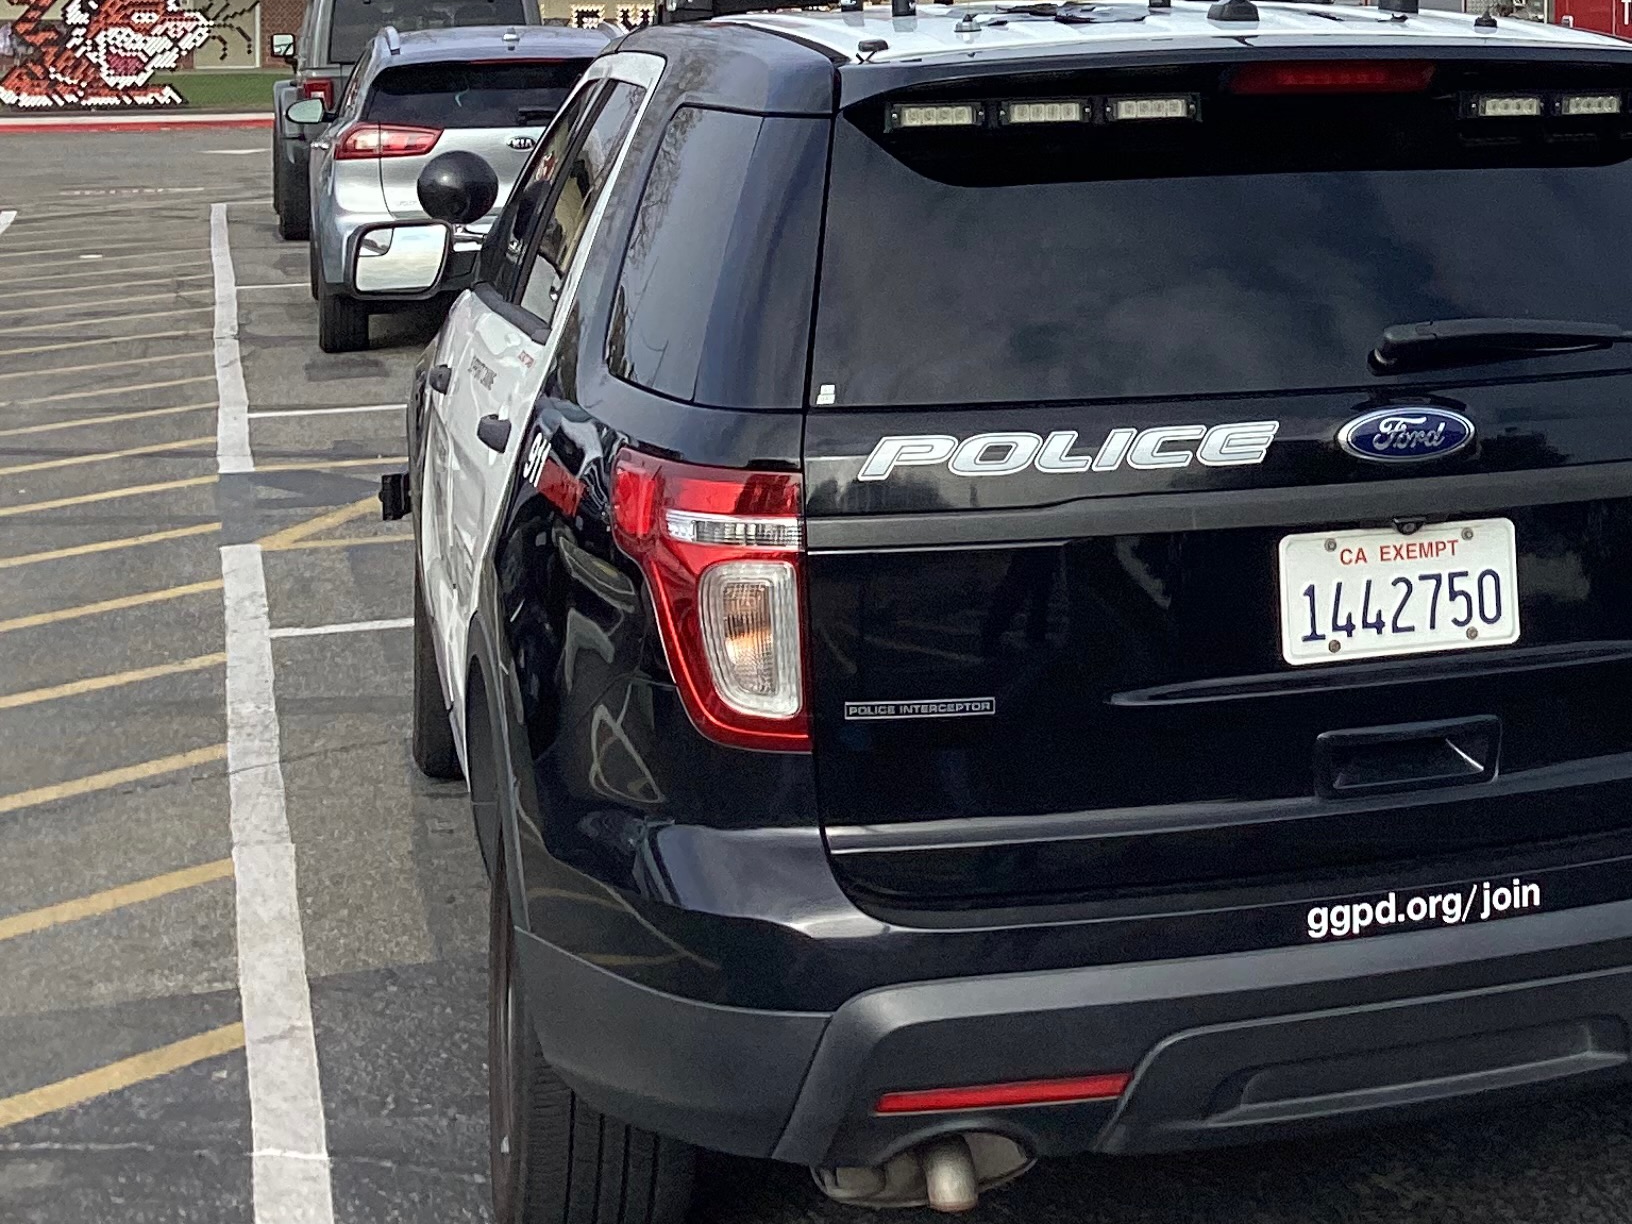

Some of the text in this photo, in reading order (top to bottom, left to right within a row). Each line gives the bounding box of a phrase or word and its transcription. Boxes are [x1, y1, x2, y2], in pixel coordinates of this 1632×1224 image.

[512, 138, 533, 148] KIA
[857, 421, 1280, 481] POLICE
[1370, 415, 1447, 452] Ford
[523, 432, 552, 488] 911
[1340, 539, 1460, 566] CA EXEMPT
[1302, 568, 1503, 643] 1442750
[849, 702, 992, 716] POLICE INTERCEPTOR
[1306, 878, 1541, 939] ggpd.org/join
